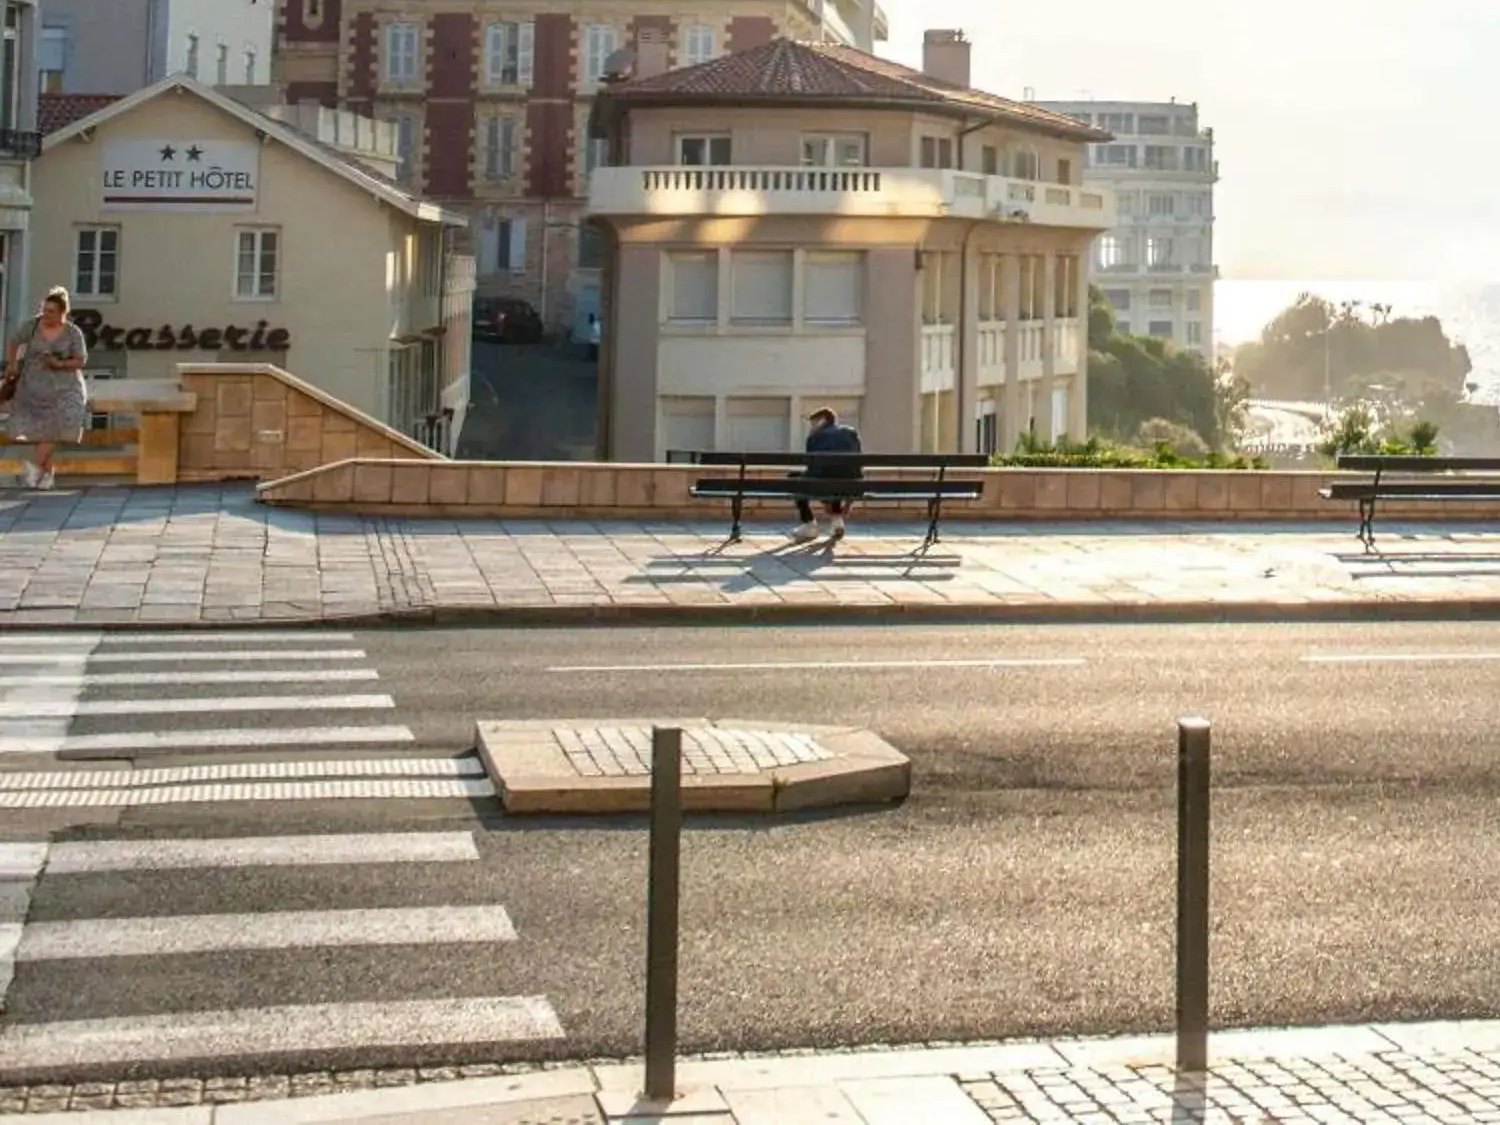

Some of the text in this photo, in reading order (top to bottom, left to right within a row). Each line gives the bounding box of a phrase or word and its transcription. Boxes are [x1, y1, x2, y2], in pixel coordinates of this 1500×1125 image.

[103, 166, 254, 189] LE PETIT HÔTEL
